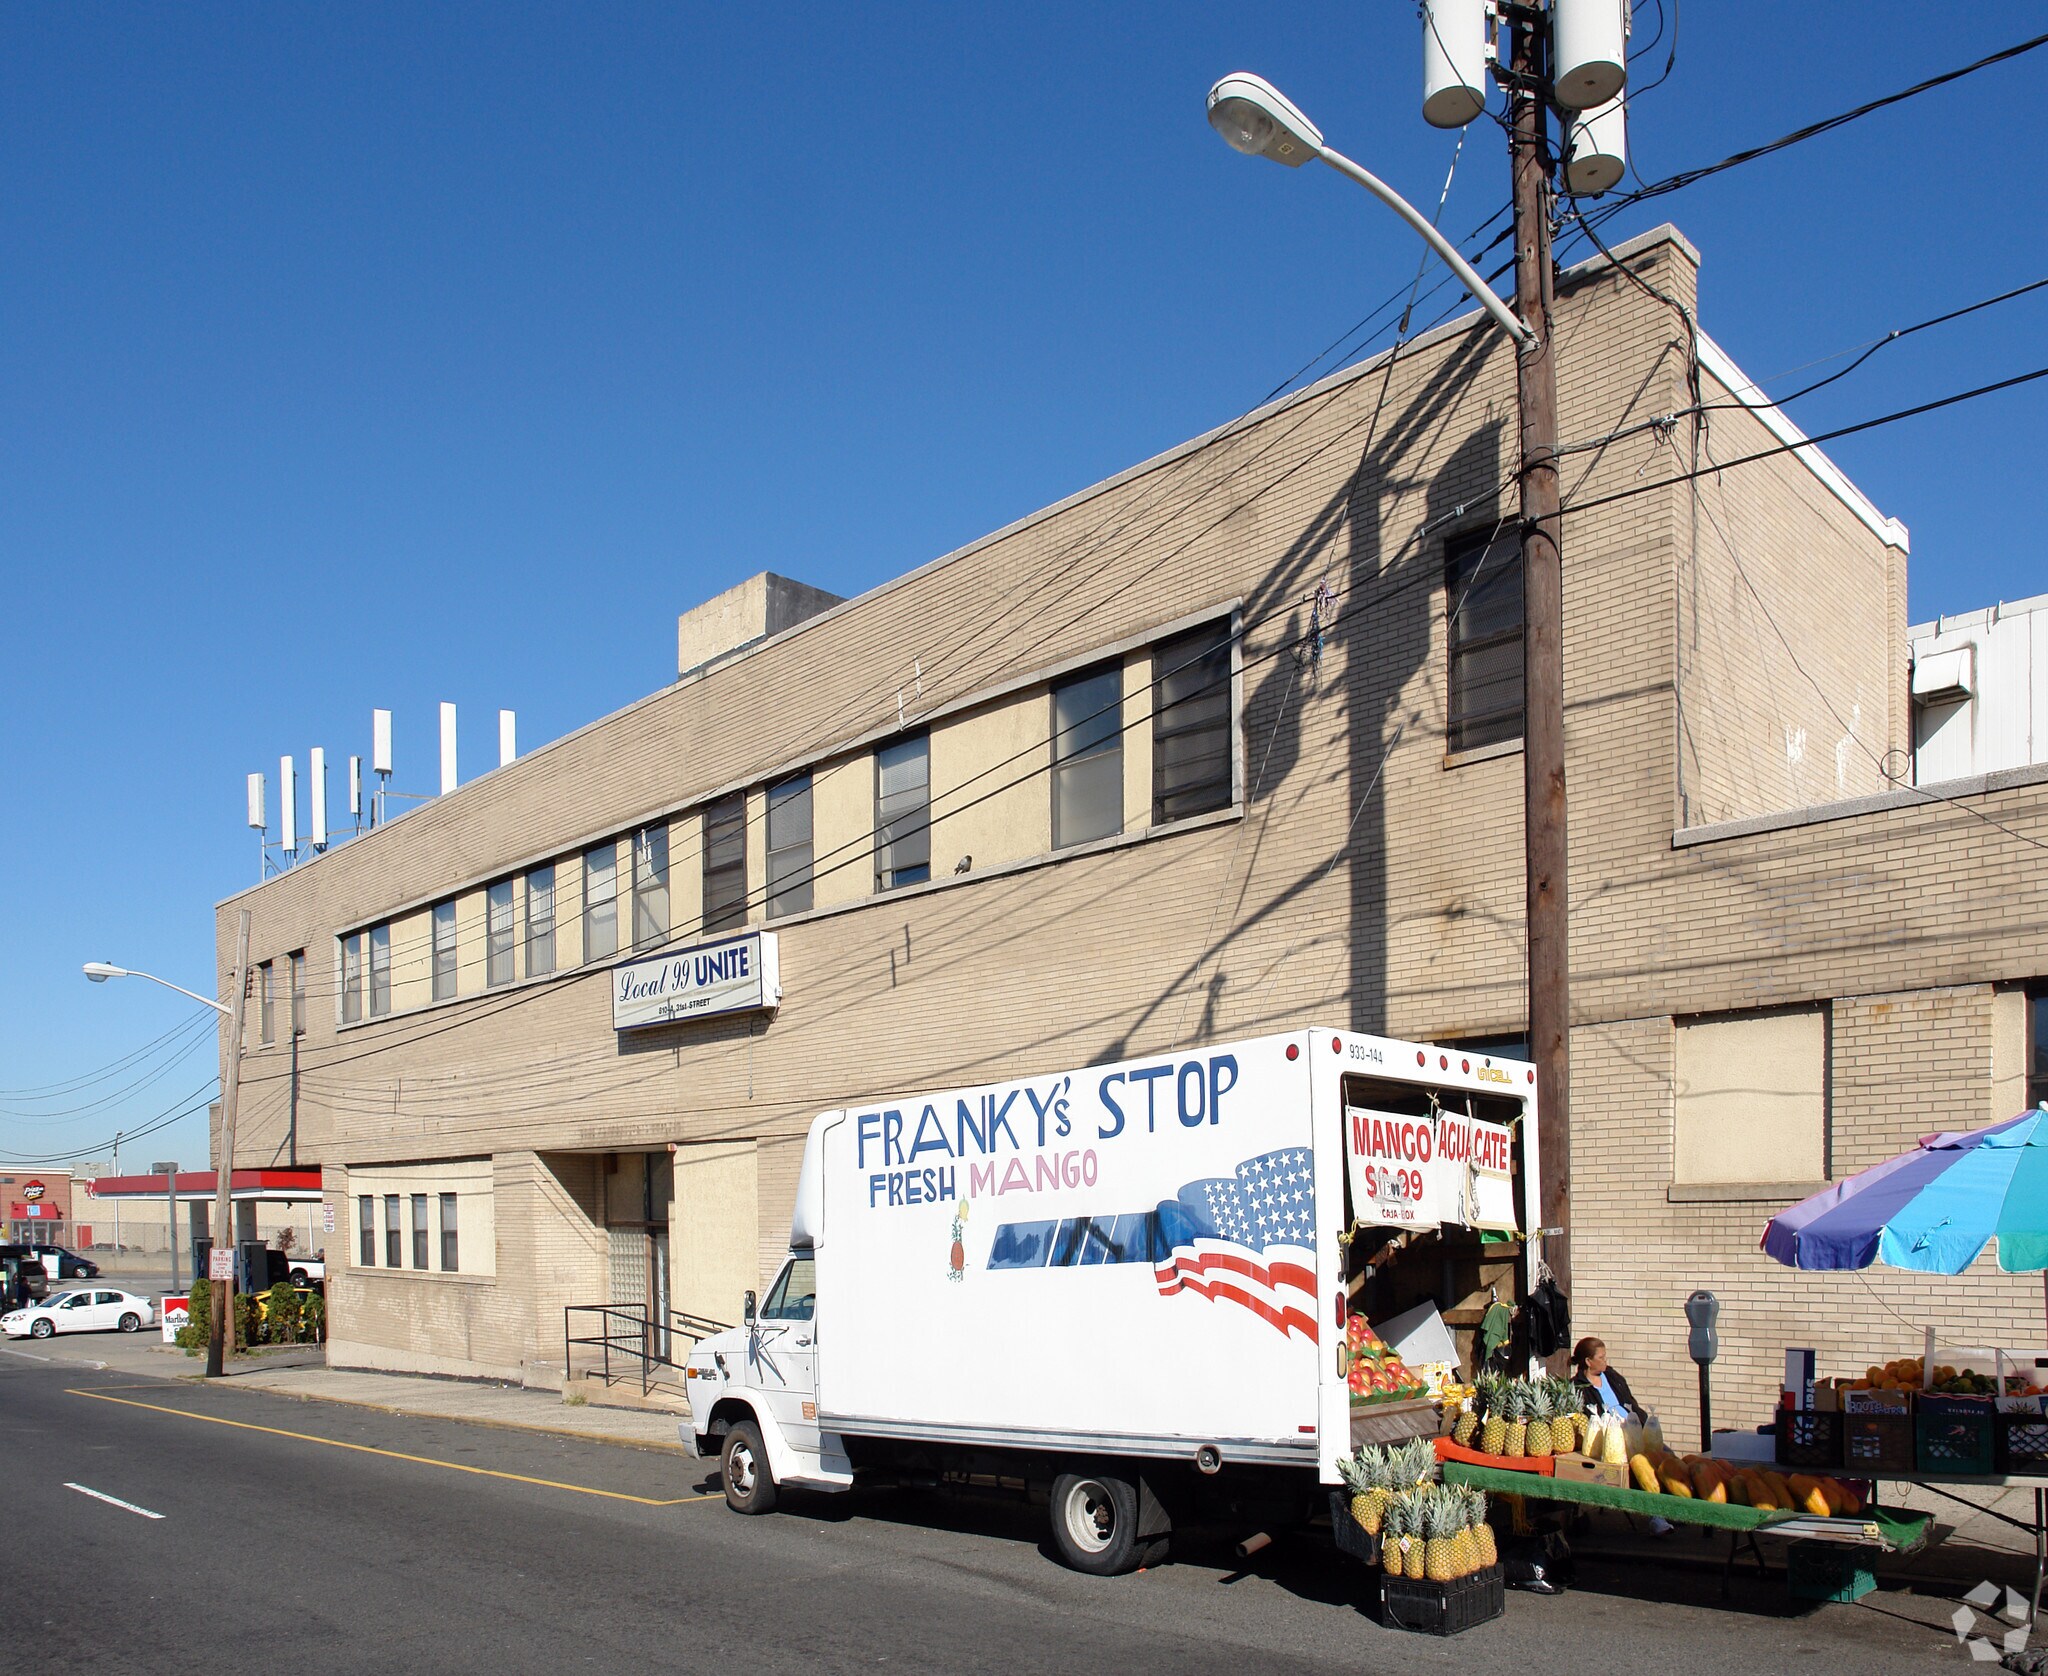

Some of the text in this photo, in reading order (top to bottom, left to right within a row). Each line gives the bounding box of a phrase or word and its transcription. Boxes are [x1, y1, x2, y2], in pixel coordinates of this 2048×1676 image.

[619, 946, 748, 1001] Local 99 UNITE
[689, 998, 711, 1009] STREET
[1349, 1044, 1383, 1064] 933-144
[1098, 1054, 1239, 1139] STOP
[1353, 1116, 1432, 1163] MANGO
[1438, 1120, 1508, 1170] AGUACATE
[24, 1186, 44, 1195] Pizza
[870, 1148, 1098, 1208] FRESH MANGO
[165, 1313, 188, 1323] Marlbo
